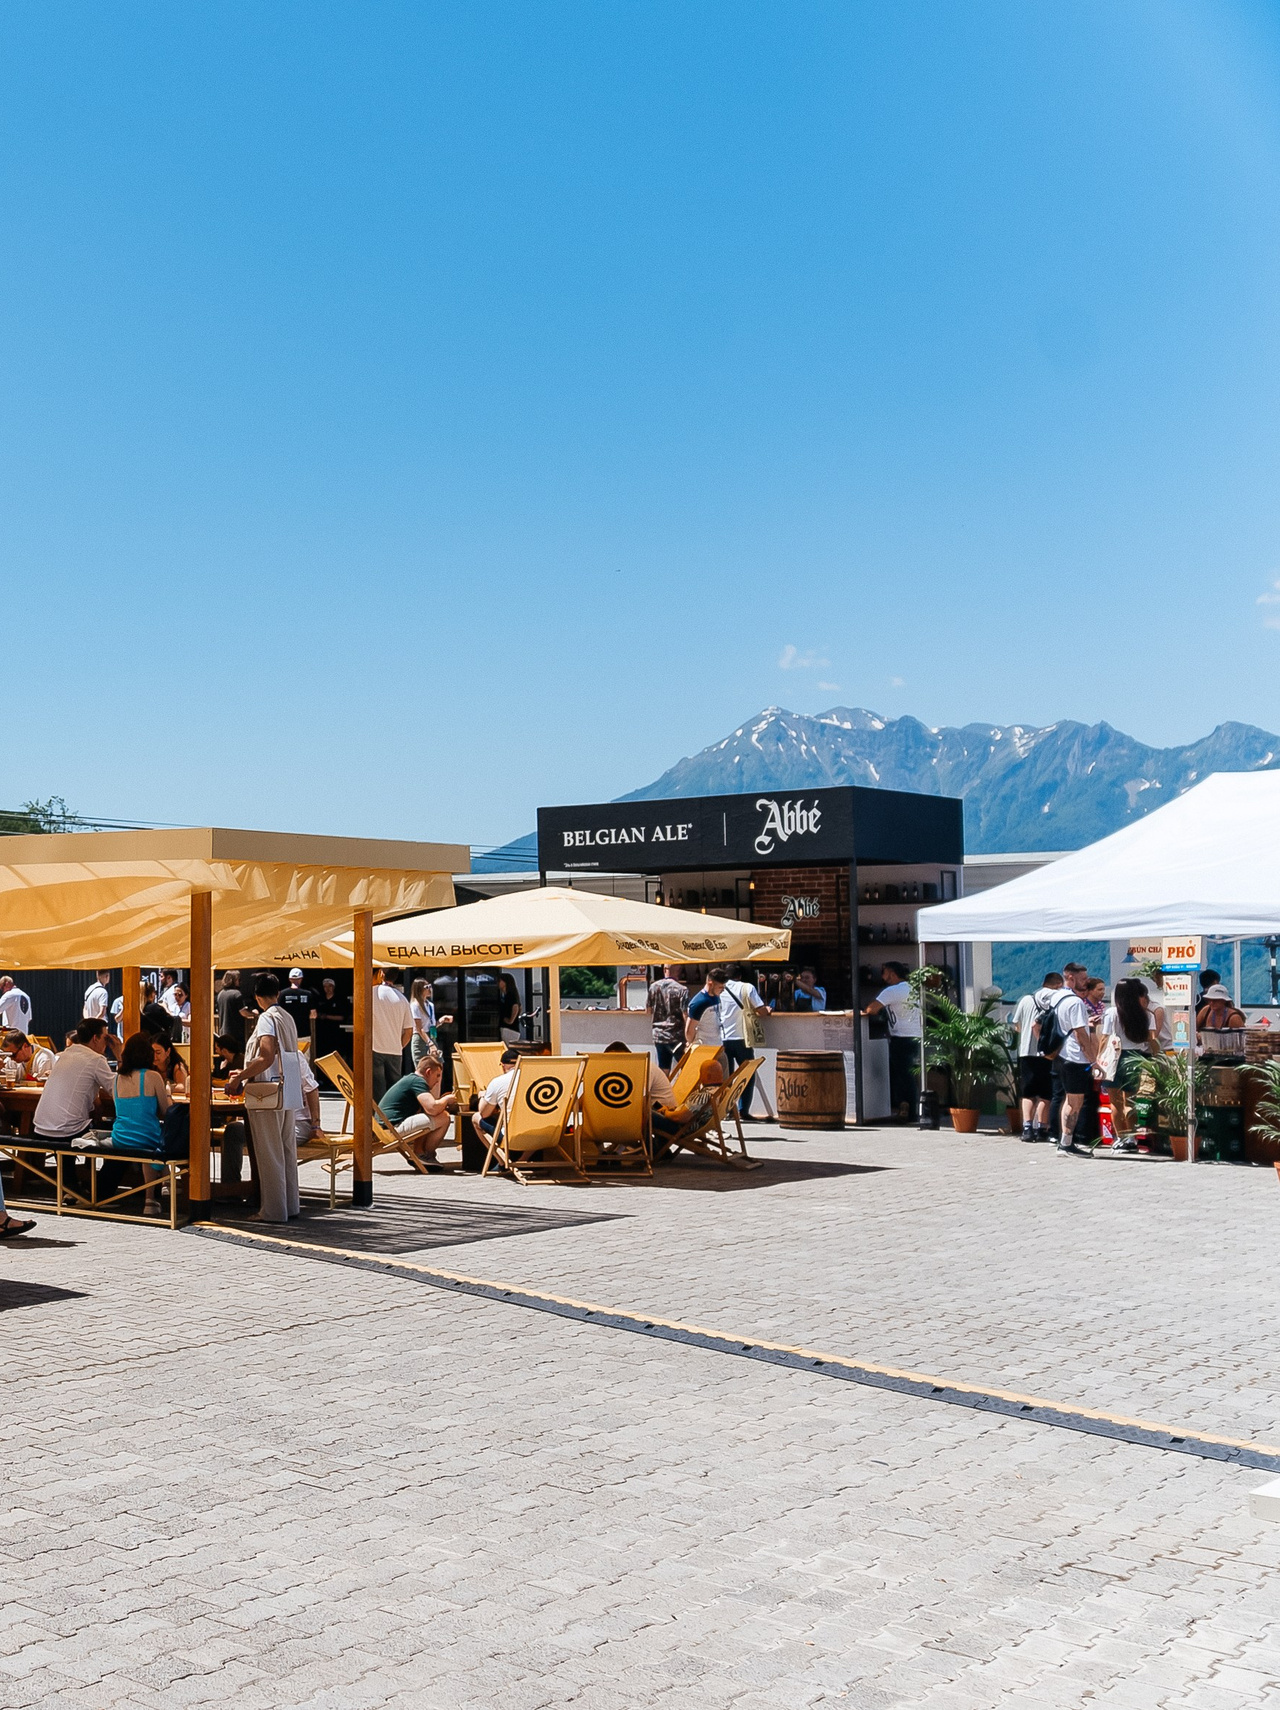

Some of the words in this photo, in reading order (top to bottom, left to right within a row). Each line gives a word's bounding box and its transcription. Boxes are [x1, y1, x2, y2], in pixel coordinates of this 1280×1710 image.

[754, 798, 822, 855] Abbé
[563, 827, 646, 847] BELGIAN
[301, 950, 320, 959] НА
[387, 946, 420, 959] ЕДА
[423, 945, 447, 957] НА
[451, 943, 524, 956] ВЫСОТЕ
[1167, 940, 1196, 958] PHỞ
[777, 1075, 808, 1107] Abbé
